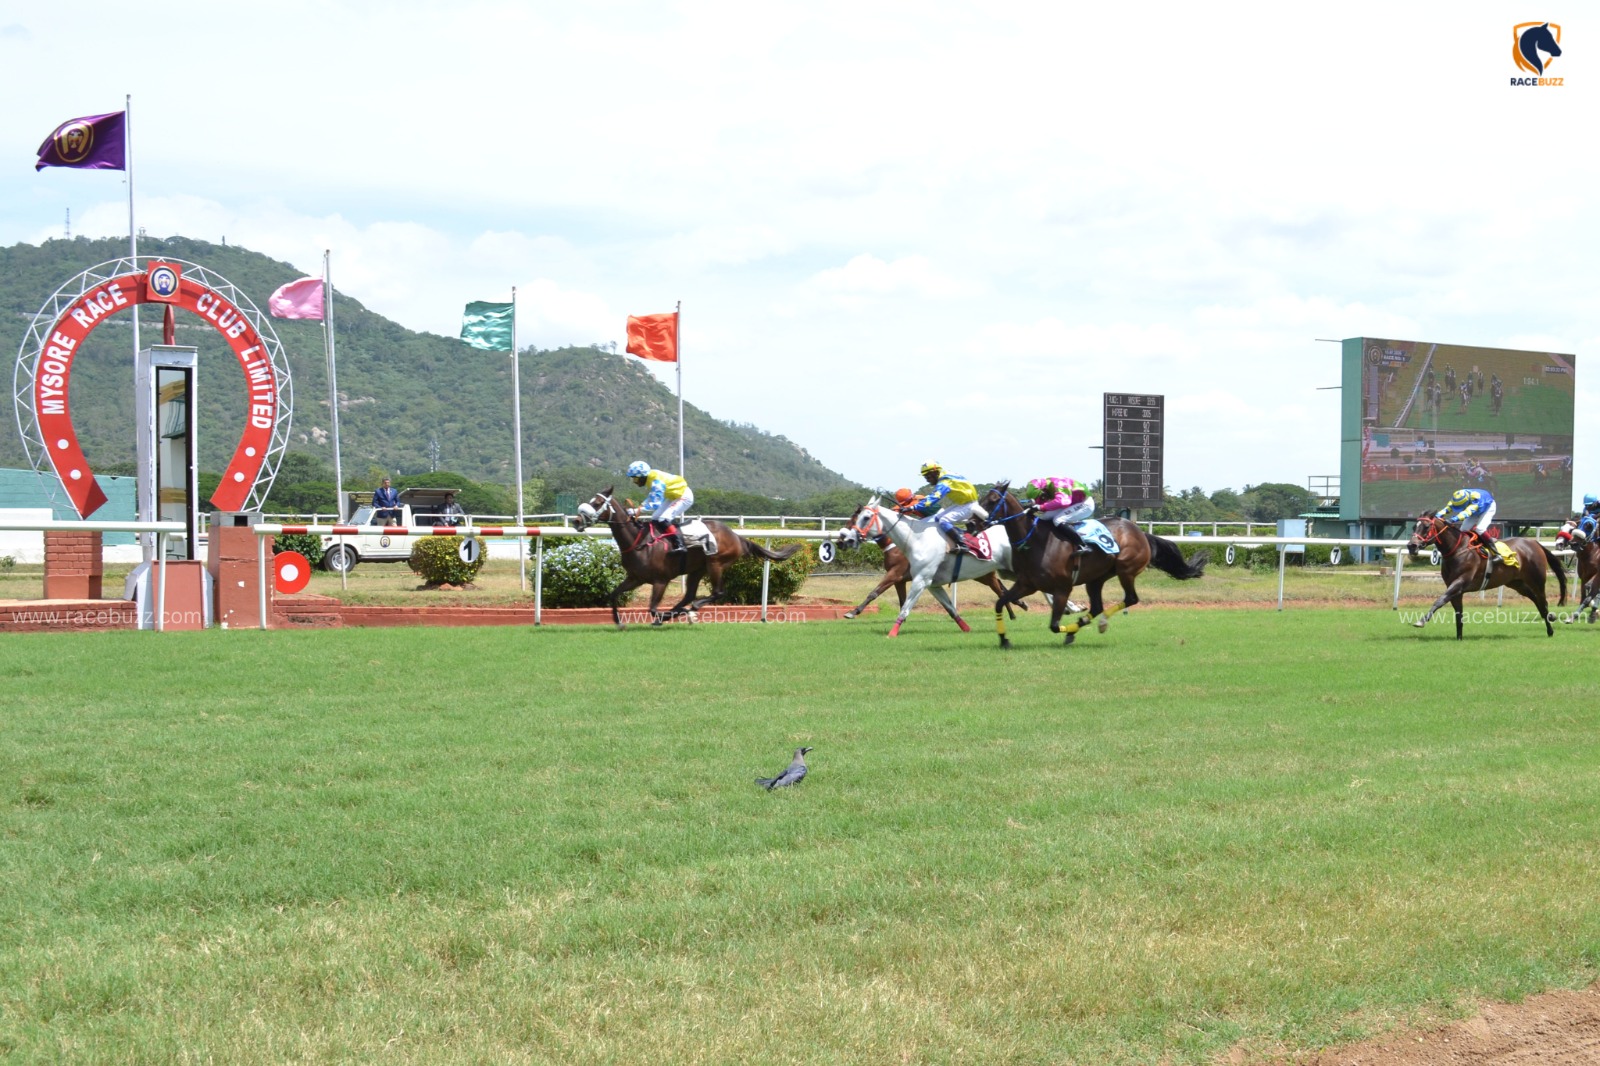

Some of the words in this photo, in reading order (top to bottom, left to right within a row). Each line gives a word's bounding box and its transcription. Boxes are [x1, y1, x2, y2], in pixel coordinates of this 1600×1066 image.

[41, 331, 77, 415] MYSORE
[71, 283, 128, 329] RACE
[195, 293, 247, 339] CLUB
[240, 345, 274, 429] LIMITED
[463, 538, 473, 561] 1
[978, 538, 990, 557] 8
[1099, 534, 1114, 548] 9
[822, 542, 832, 561] 3
[1228, 547, 1233, 563] 6
[1333, 549, 1340, 563] 7
[1432, 551, 1438, 564] 8
